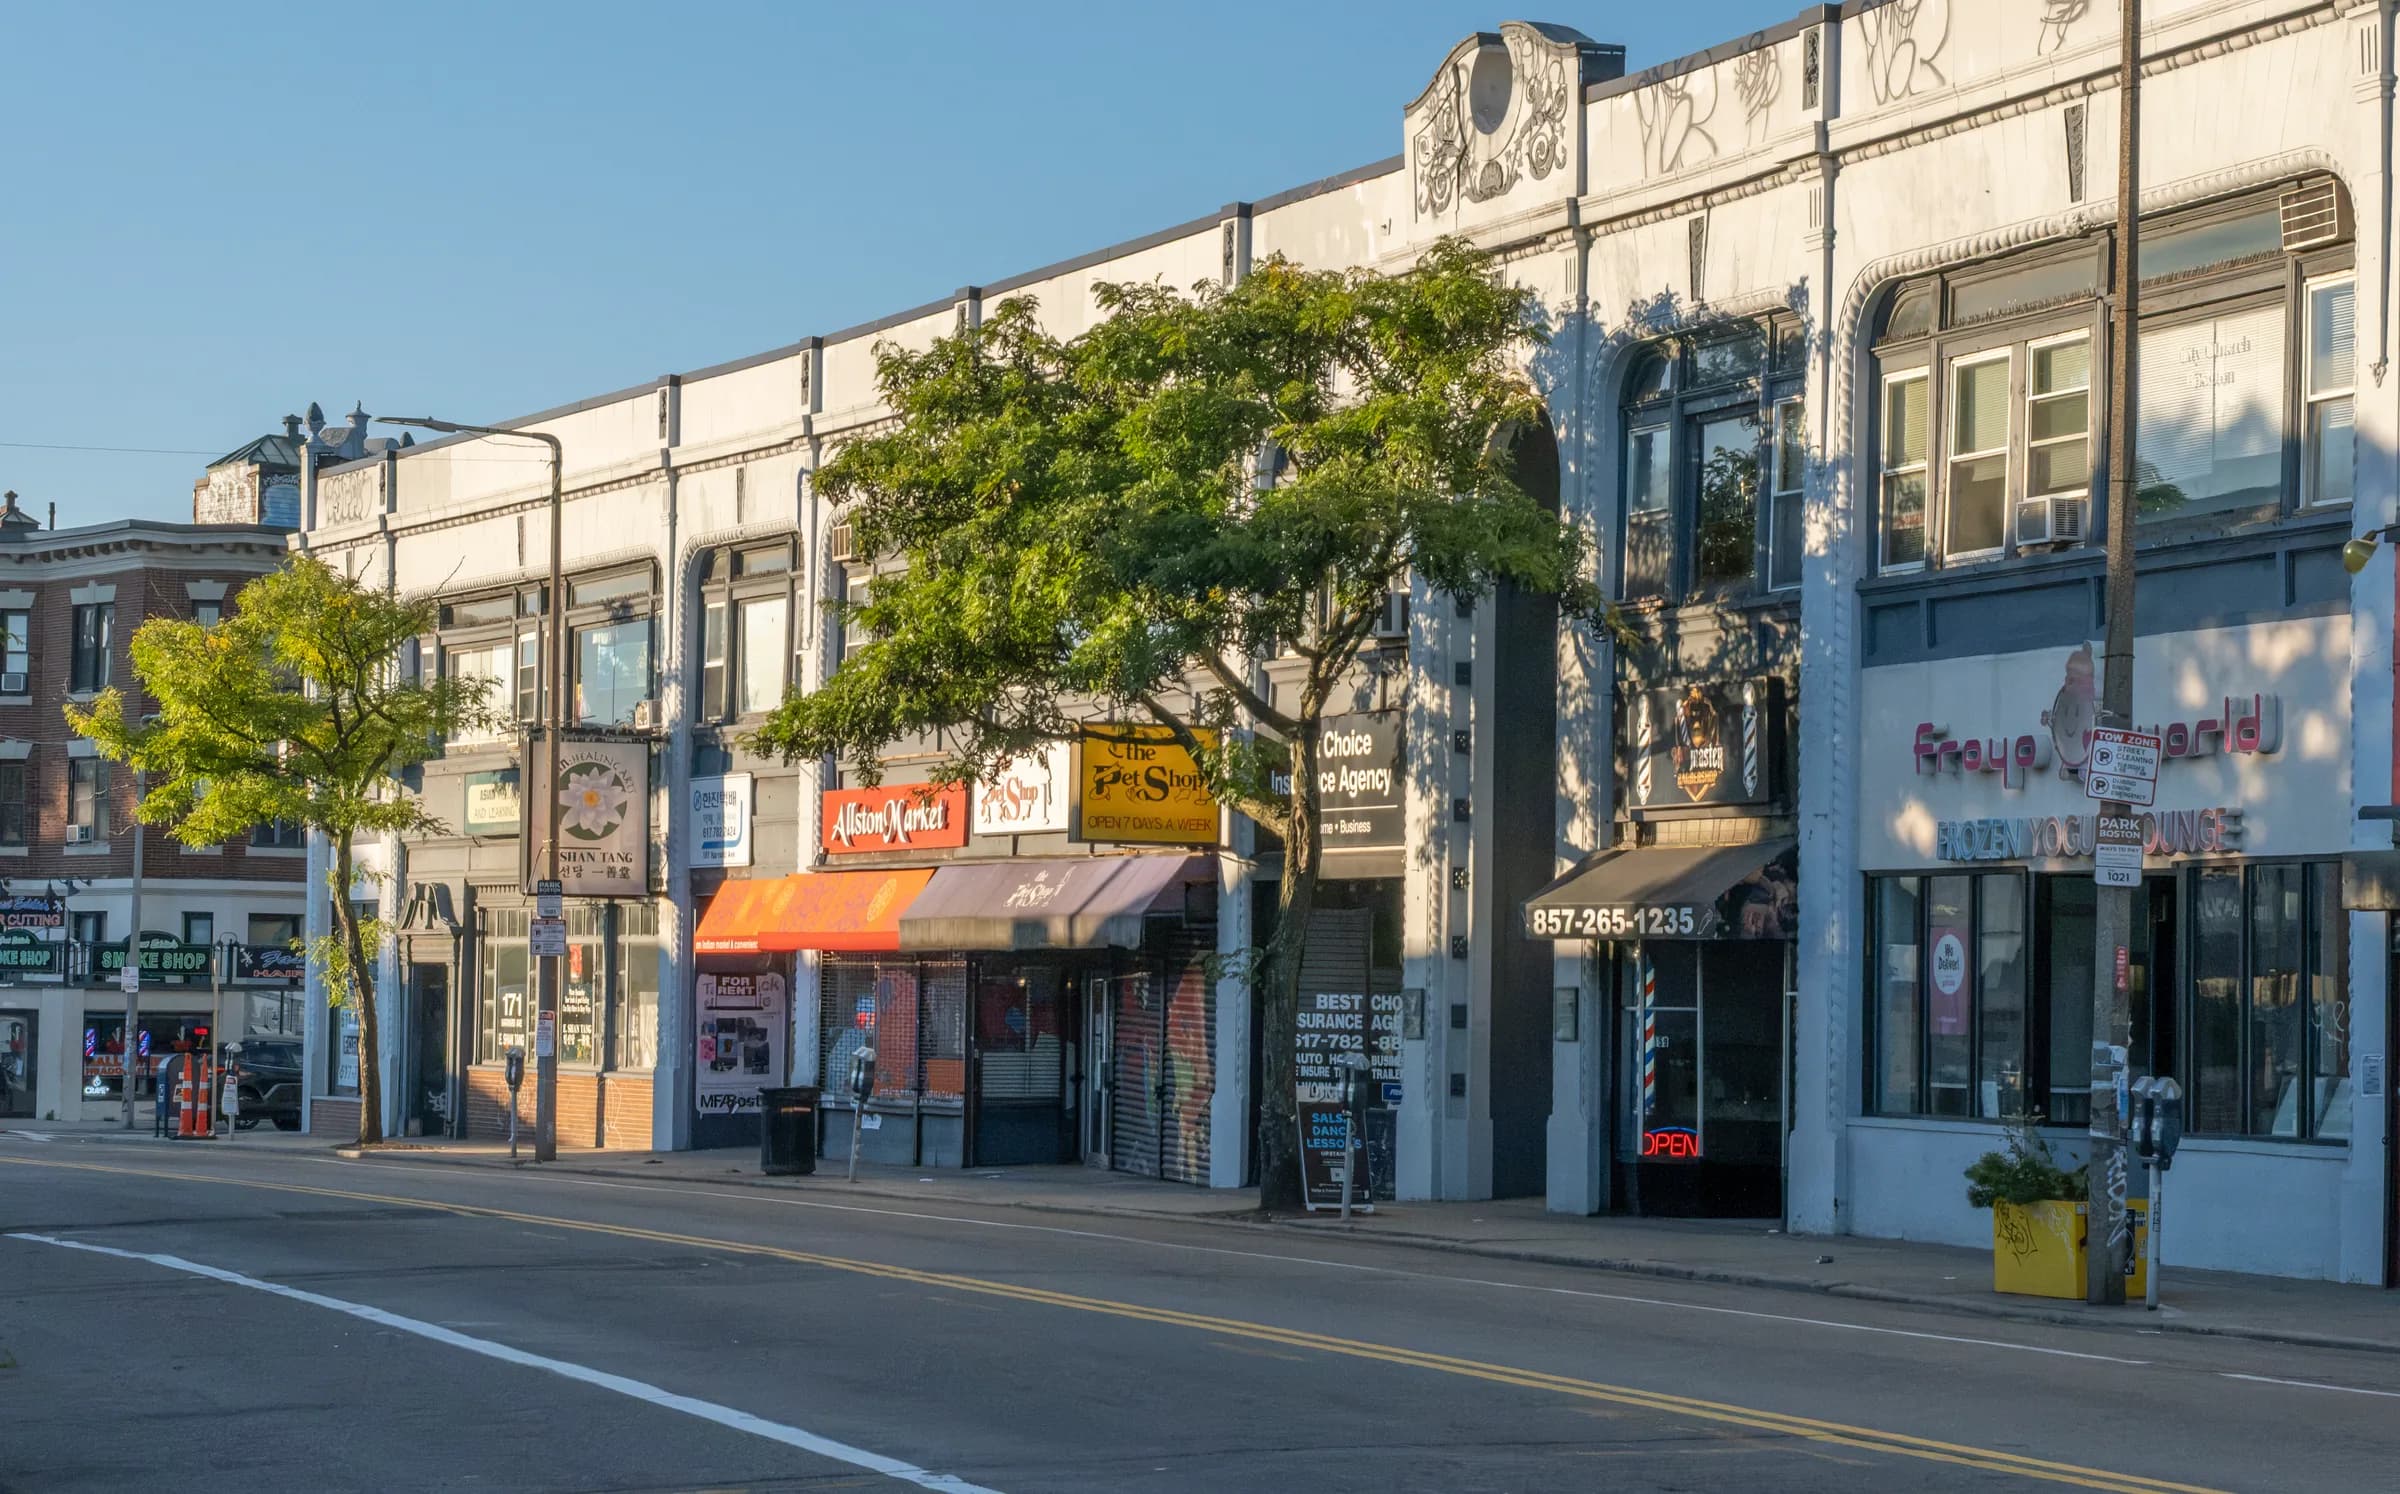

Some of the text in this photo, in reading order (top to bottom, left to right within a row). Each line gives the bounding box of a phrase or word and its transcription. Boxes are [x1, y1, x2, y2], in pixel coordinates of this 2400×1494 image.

[1324, 728, 1372, 758] Choice
[1913, 693, 2261, 790] froyo orld
[2097, 731, 2157, 747] TOW ZONE
[1126, 742, 1156, 760] the
[2117, 745, 2146, 755] STREET
[2116, 753, 2154, 764] CLEANING
[1093, 761, 1206, 802] Pet Shop
[1339, 765, 1392, 798] Agency
[831, 799, 947, 847] Allston Market
[1088, 815, 1212, 831] OPEN 7 DAYS A WEEK
[1340, 819, 1371, 834] Business
[2100, 816, 2141, 831] PARK
[1937, 817, 2022, 860] FROZEN
[2100, 830, 2141, 839] BOSTON
[560, 851, 633, 863] SHAN TANG
[2107, 871, 2130, 881] 1021
[7, 914, 60, 926] CUTTING
[1533, 907, 1694, 935] 857-265-1235
[20, 951, 50, 966] SHOP
[102, 951, 206, 970] SMKE SHOP
[721, 976, 750, 986] FOR
[717, 986, 755, 995] RENT
[502, 993, 522, 1016] 171
[1316, 994, 1364, 1010] BEST
[1312, 1112, 1347, 1123] SALS
[1306, 1137, 1362, 1149] LESSOS
